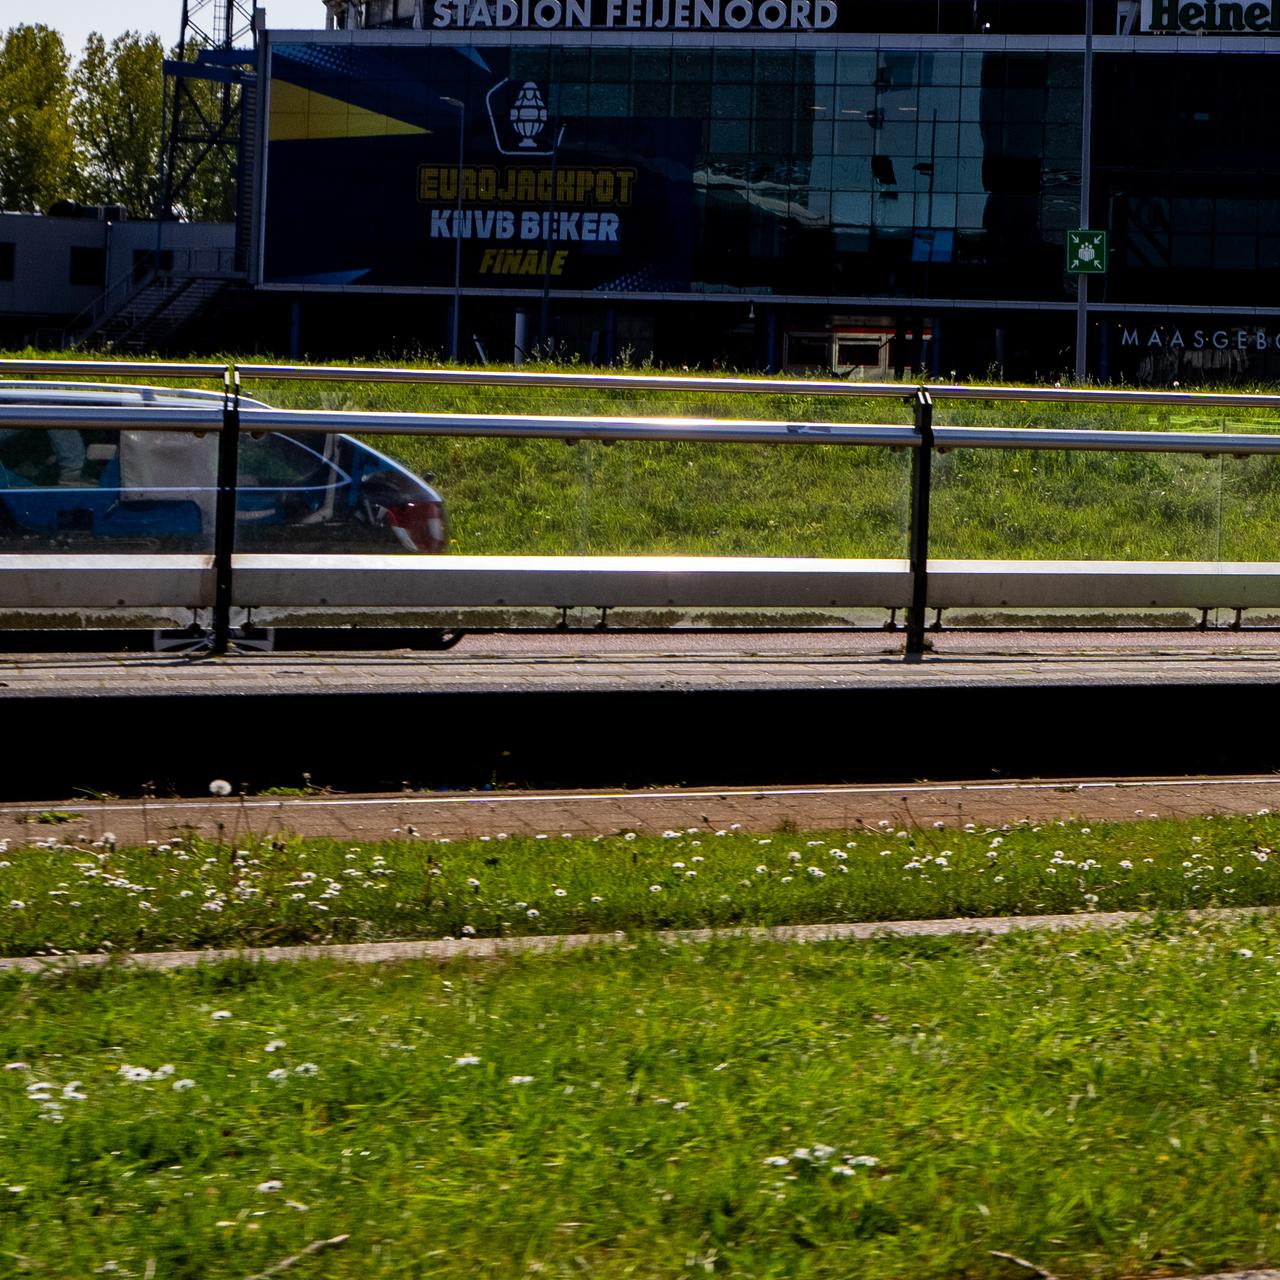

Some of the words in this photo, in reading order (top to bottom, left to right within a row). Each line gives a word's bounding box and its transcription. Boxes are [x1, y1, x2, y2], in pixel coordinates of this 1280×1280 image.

[418, 166, 636, 205] EUROJACKPOT
[429, 208, 515, 240] KNVB
[519, 210, 621, 241] BEKER
[479, 248, 569, 276] FINALE
